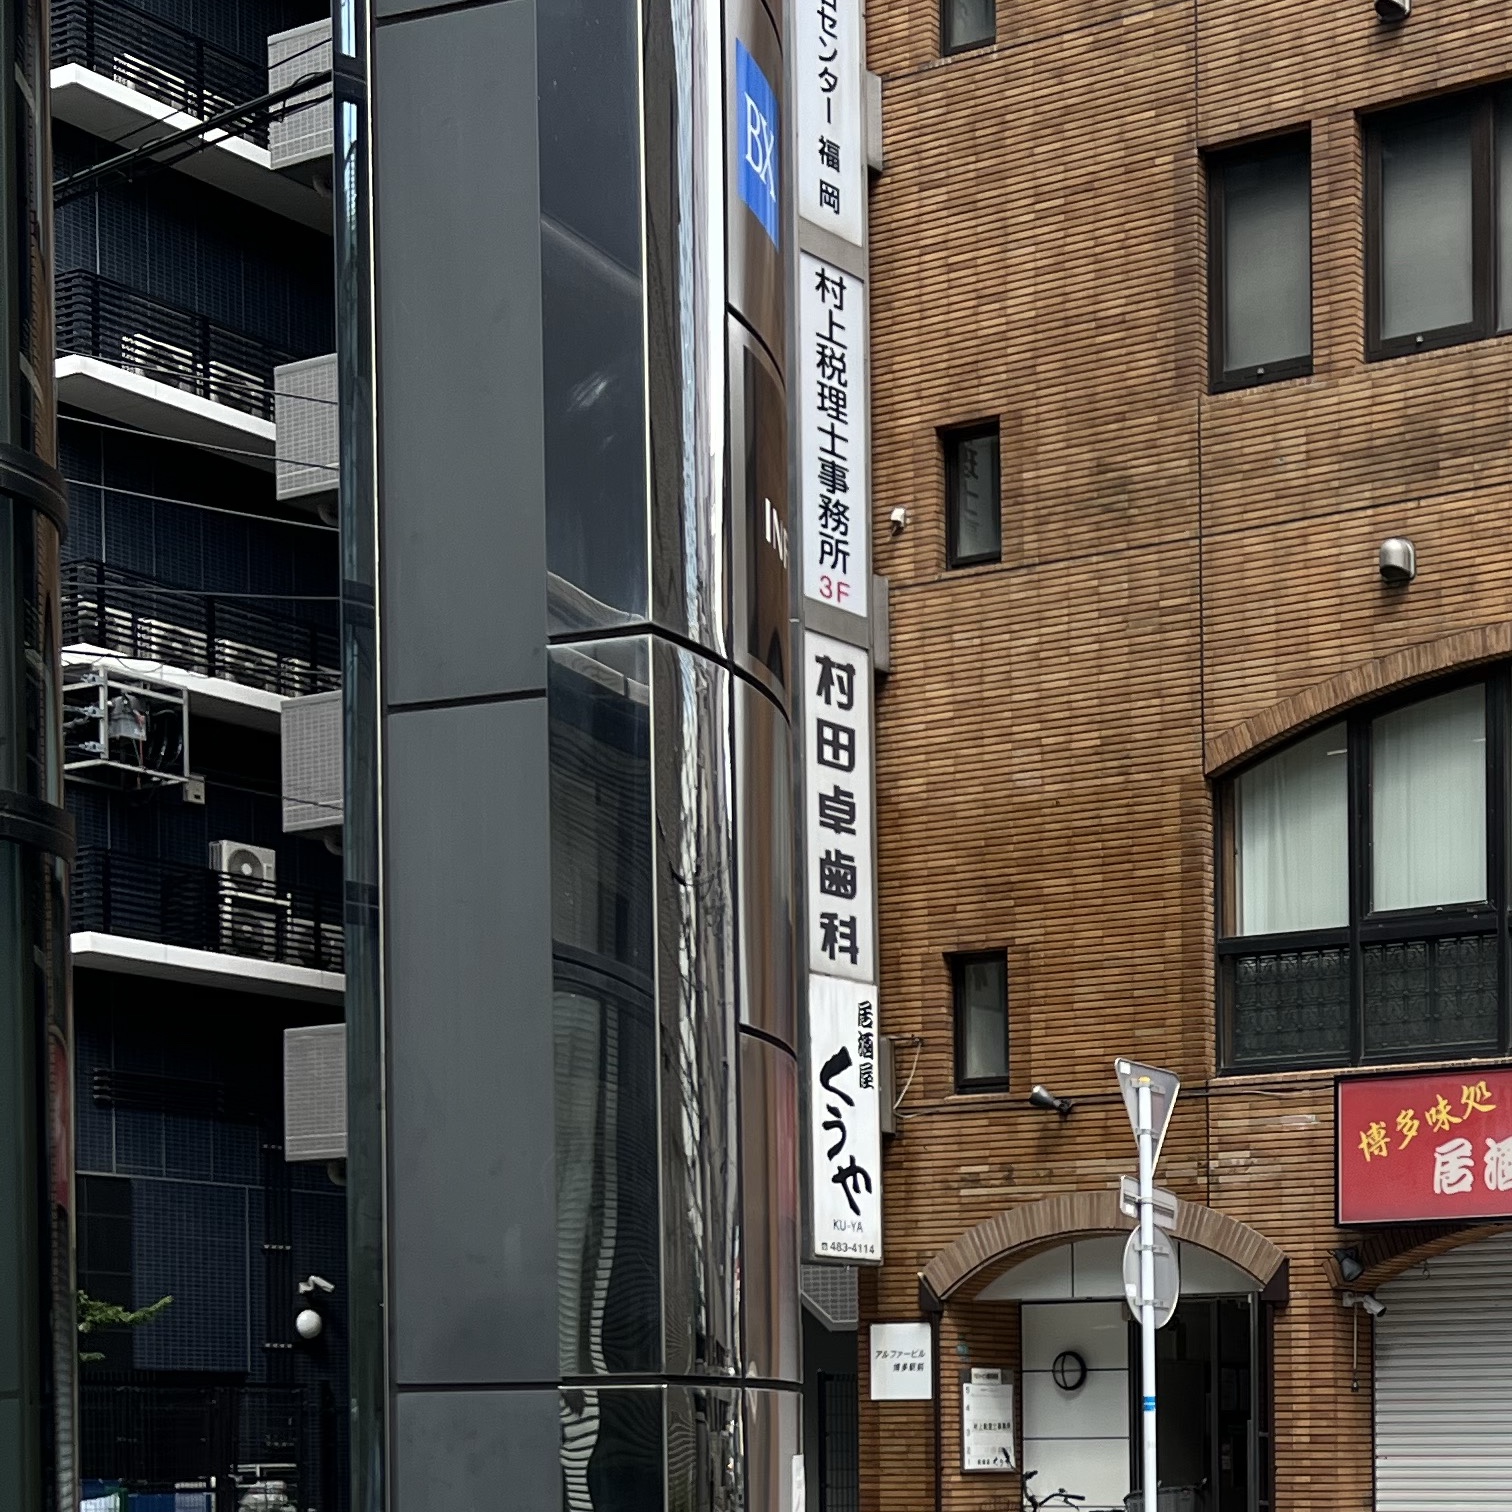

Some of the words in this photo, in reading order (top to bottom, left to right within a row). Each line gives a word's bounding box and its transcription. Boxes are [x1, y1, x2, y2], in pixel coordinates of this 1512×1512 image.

[744, 91, 776, 203] BX
[818, 135, 840, 215] 福岡
[815, 267, 850, 575] 村上税理士事務所
[818, 575, 851, 604] 3F
[815, 654, 860, 966] 村田卓歯科
[859, 1000, 874, 1090] 居酒屋
[819, 1045, 873, 1217] くうや
[1357, 1080, 1497, 1162] 博多味処
[830, 1242, 875, 1254] 483-4114
[833, 1219, 864, 1232] KU-YA
[875, 1350, 925, 1359] アルファービル
